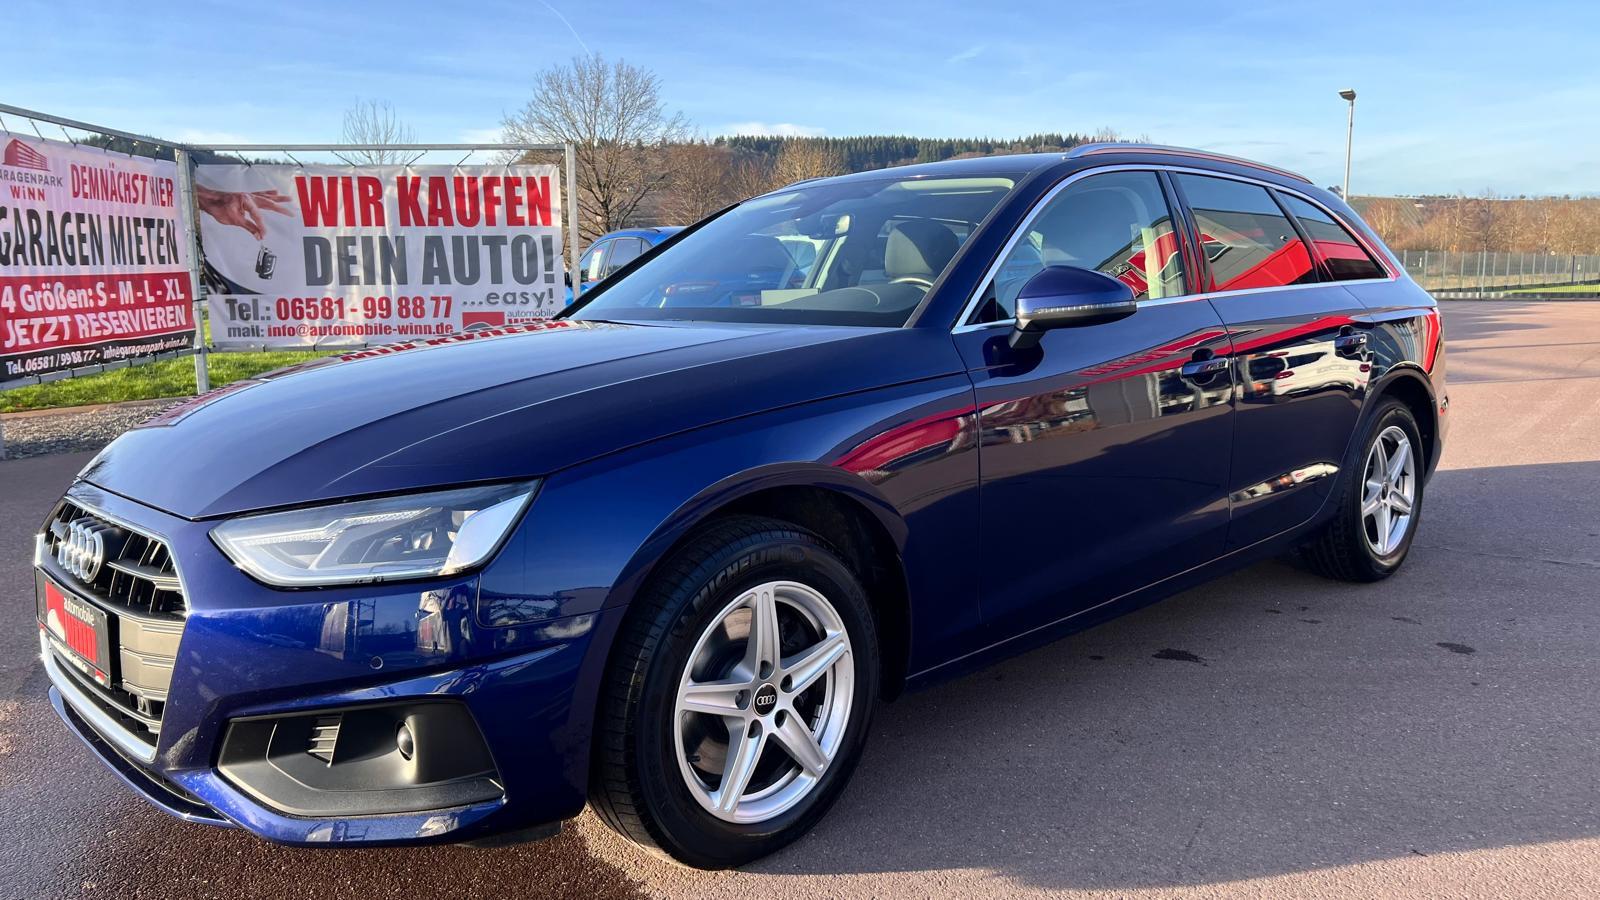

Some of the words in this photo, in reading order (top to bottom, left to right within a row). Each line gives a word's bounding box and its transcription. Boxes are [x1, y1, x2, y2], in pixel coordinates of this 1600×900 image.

[70, 162, 147, 205] DEMNÄCHST
[149, 175, 174, 208] HIER
[295, 175, 386, 228] WIR
[396, 175, 553, 228] KAUFEN
[0, 206, 104, 266] GARAGEN
[108, 215, 179, 266] MIETEN
[302, 235, 408, 286] DEIN
[422, 234, 555, 286] AUTO!
[1, 285, 17, 313] 4
[20, 281, 95, 313] Größen:
[96, 281, 107, 307] S
[118, 281, 134, 305] M
[144, 280, 155, 302] L
[163, 278, 185, 301] XL
[225, 298, 271, 321] Tel.:
[276, 297, 345, 321] 06581
[363, 296, 392, 320] 99
[397, 295, 426, 319] 88
[430, 295, 453, 318] 77
[507, 308, 556, 318] automobile
[4, 315, 71, 348] JETZT
[74, 304, 186, 339] RESERVIEREN
[227, 324, 264, 338] mail:
[267, 322, 454, 338] info@automobile-winn.de
[6, 360, 24, 375] Tel.
[692, 546, 783, 616] MICHELIN
[64, 596, 95, 627] automobile
